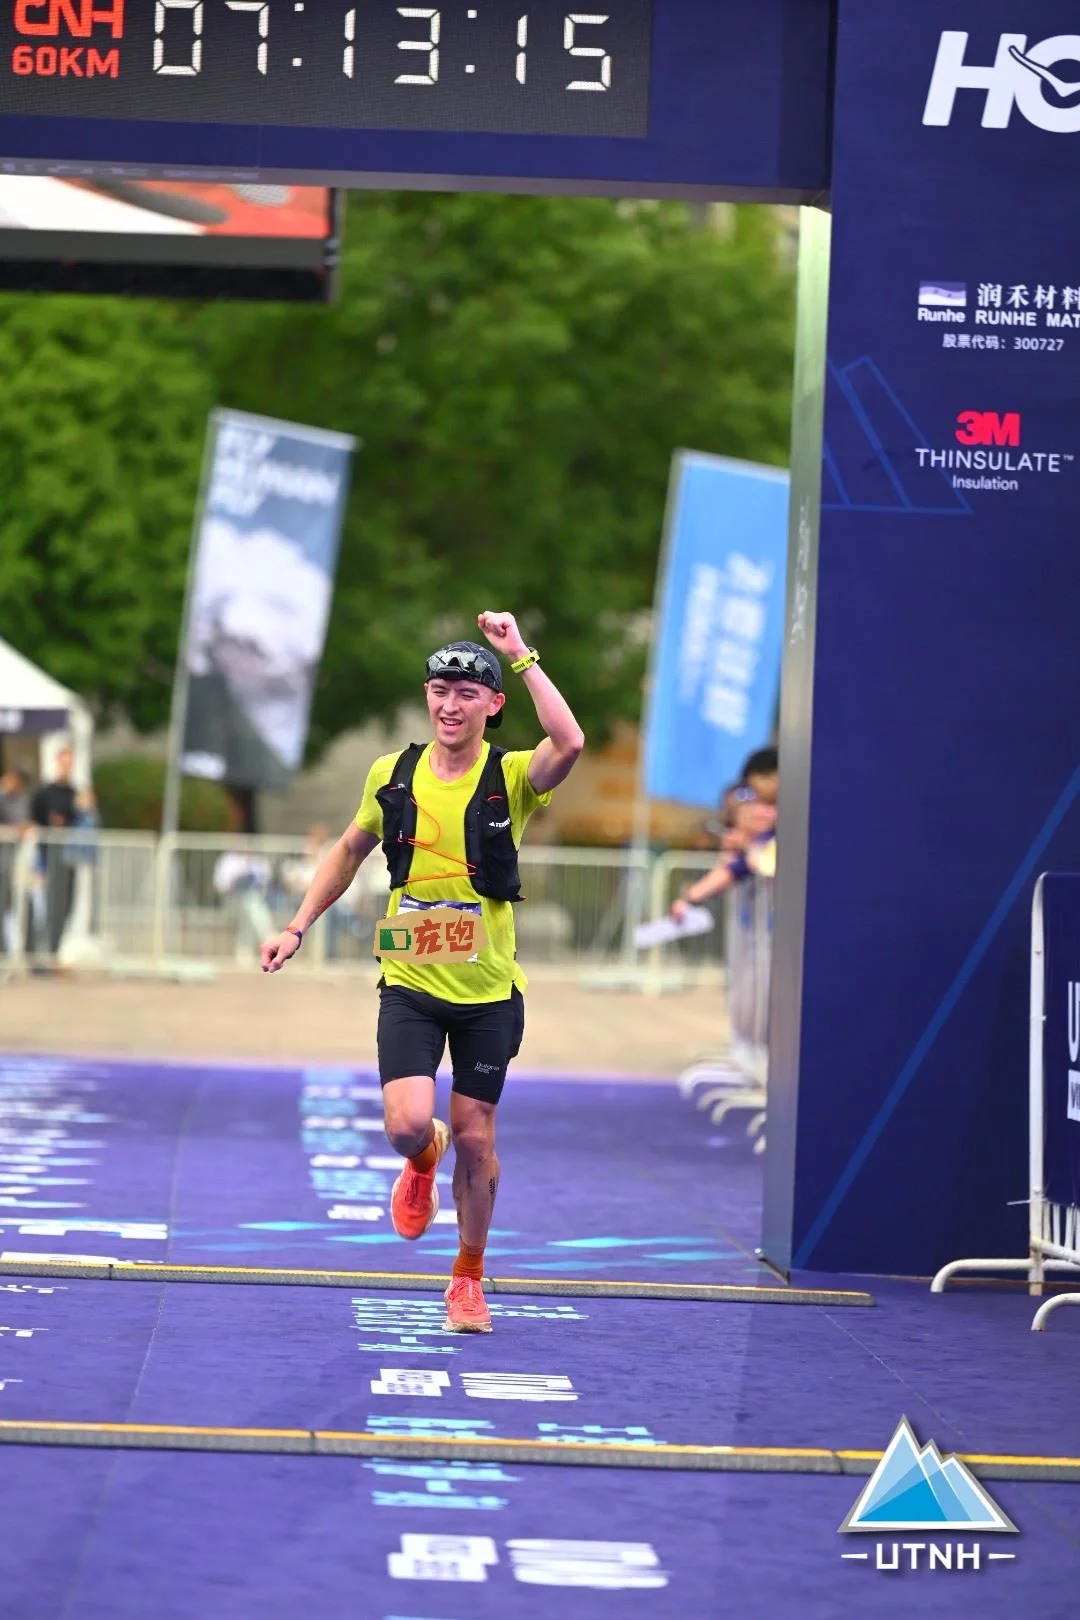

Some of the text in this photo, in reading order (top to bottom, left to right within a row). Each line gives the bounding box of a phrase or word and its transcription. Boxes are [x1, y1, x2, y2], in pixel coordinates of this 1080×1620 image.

[14, 0, 124, 38] CNH
[152, 0, 612, 92] 07:13:15
[12, 44, 120, 78] 60KM
[977, 283, 1080, 311] 润禾材料
[917, 307, 966, 323] Runhe
[975, 309, 1037, 327] RUNHE
[1013, 336, 1065, 351] 300727
[955, 410, 1021, 447] 3M
[952, 474, 1018, 491] Insulation
